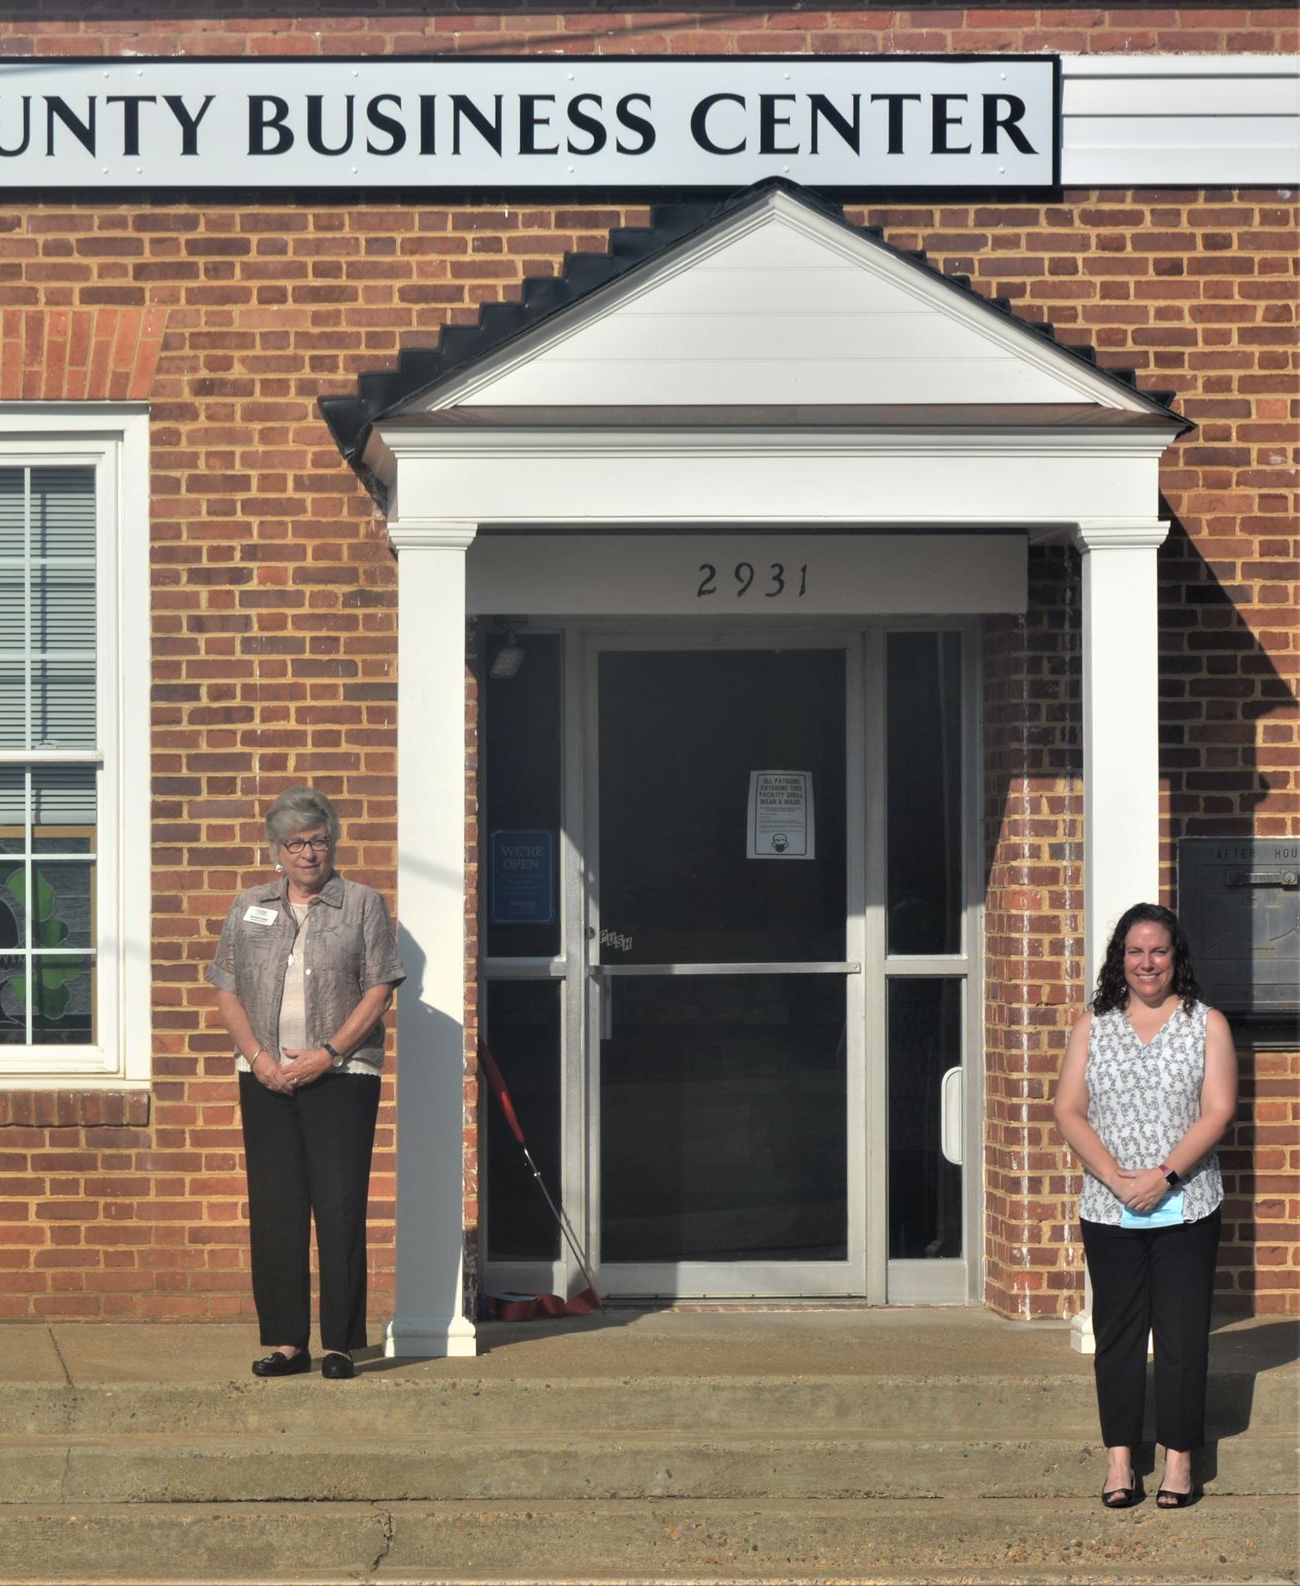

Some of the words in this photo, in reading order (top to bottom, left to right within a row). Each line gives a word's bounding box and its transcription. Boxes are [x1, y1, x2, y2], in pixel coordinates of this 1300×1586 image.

[247, 93, 656, 157] BUSINESS
[690, 92, 1039, 156] CENTER
[697, 562, 808, 598] 2931
[500, 846, 545, 857] WE'RE
[1215, 848, 1256, 860] AFTER
[502, 858, 540, 870] OPEN
[600, 929, 633, 951] PUSH
